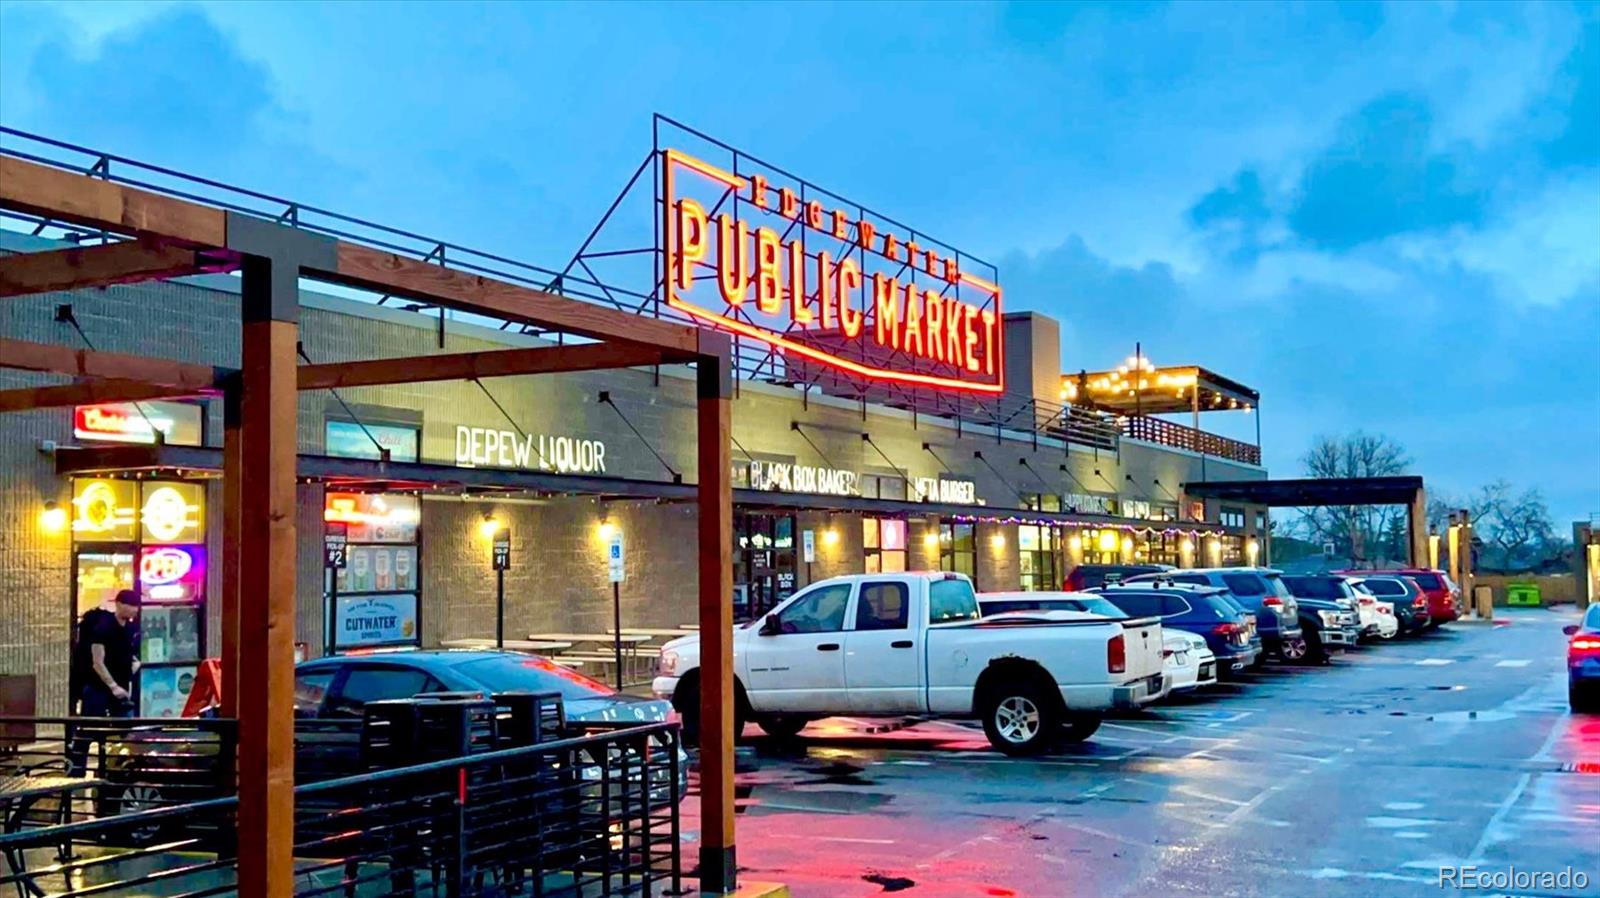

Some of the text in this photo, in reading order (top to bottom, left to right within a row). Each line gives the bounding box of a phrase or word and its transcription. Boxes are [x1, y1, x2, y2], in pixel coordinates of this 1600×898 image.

[751, 175, 961, 284] EDGEWATER
[676, 199, 997, 376] PUBLIC MARKET
[456, 425, 606, 473] DEPEW LIQUOR
[750, 460, 862, 496] BLACK BOX BAKERY
[915, 476, 976, 505] META BURGER
[329, 550, 343, 565] #2
[345, 616, 397, 631] CUTWATER
